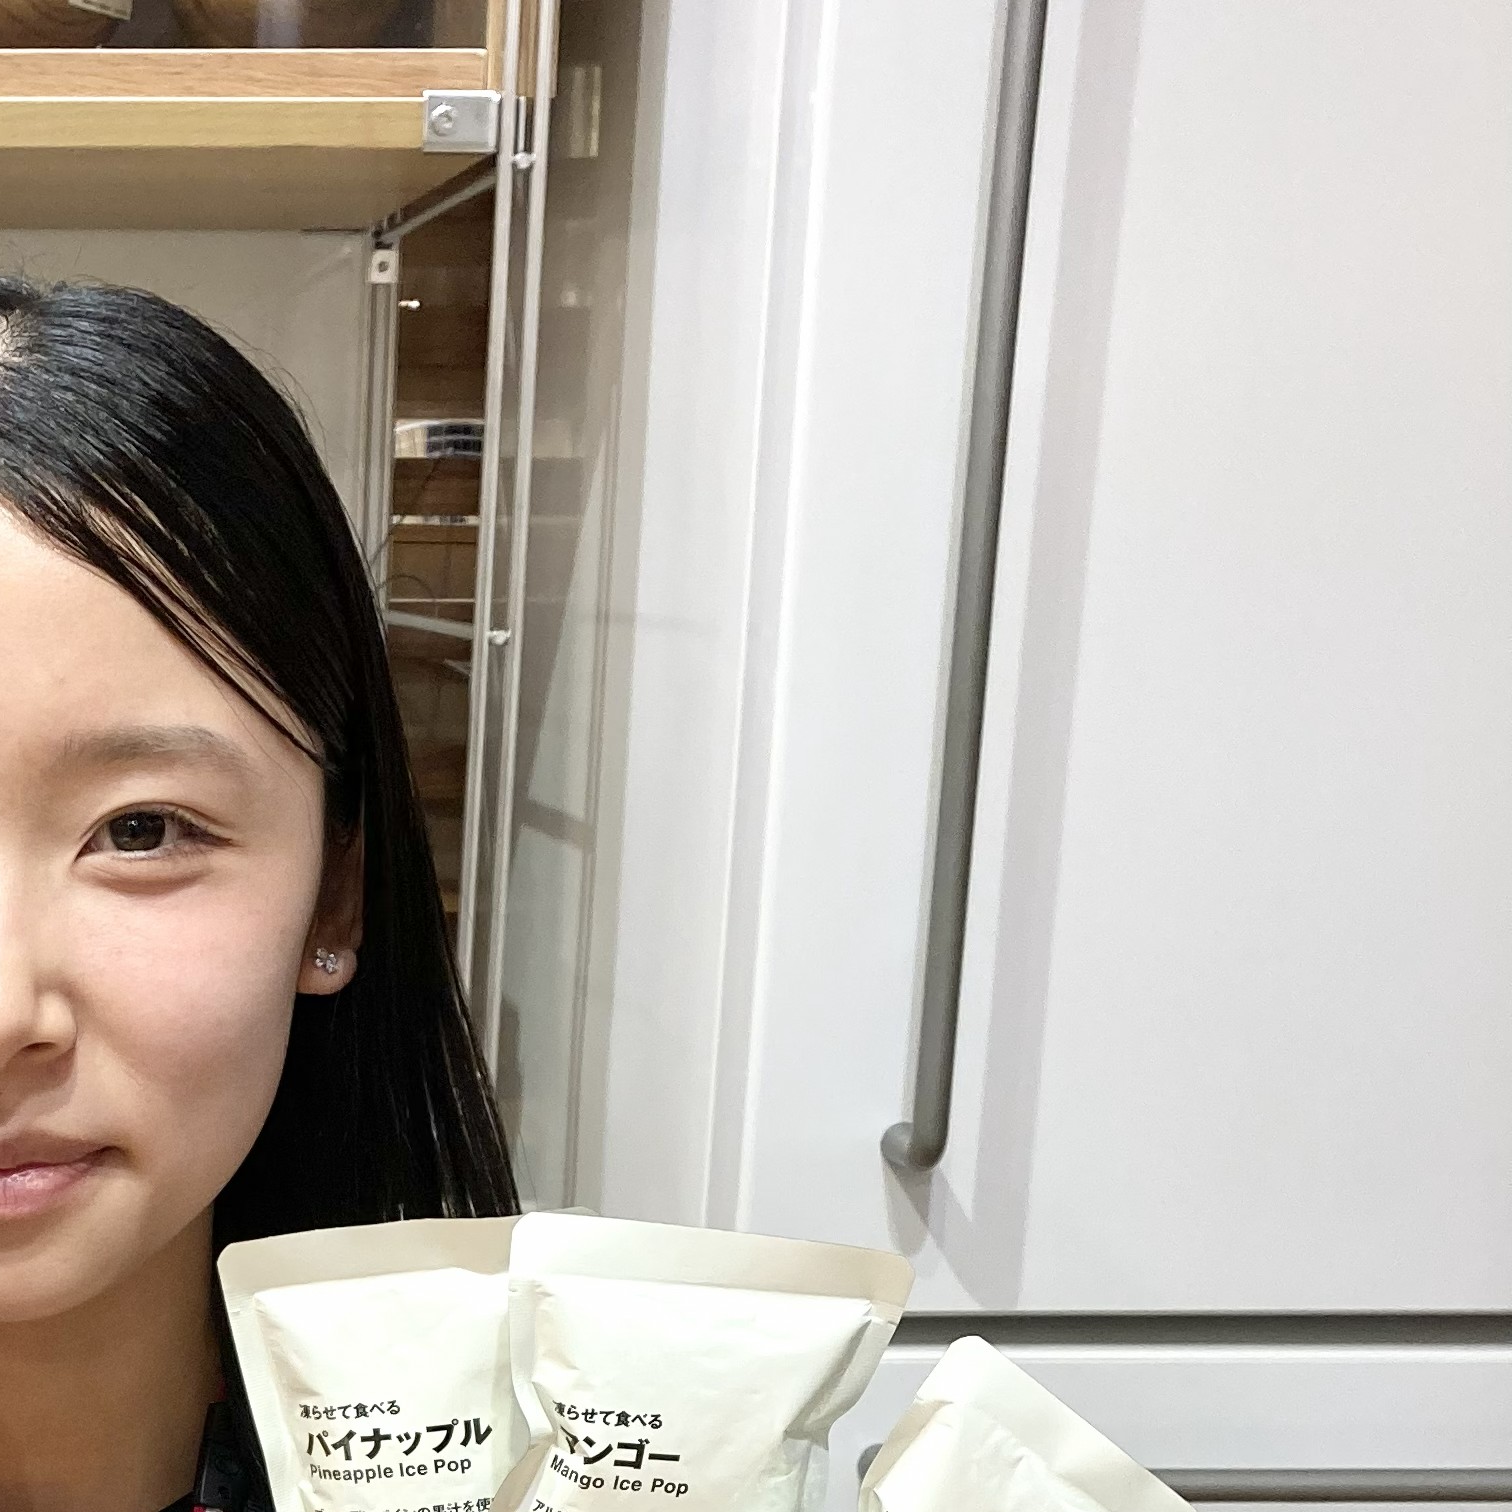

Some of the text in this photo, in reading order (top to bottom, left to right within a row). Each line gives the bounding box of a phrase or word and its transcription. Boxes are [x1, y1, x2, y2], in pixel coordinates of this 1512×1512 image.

[299, 1400, 402, 1420] 凍らせて食べる
[553, 1400, 663, 1430] 凍らせて食べる
[306, 1417, 493, 1461] パイナップル
[560, 1425, 681, 1470] マンゴー
[310, 1458, 472, 1485] Pineapple Ice Pop
[550, 1453, 689, 1498] Mango Ice Pop
